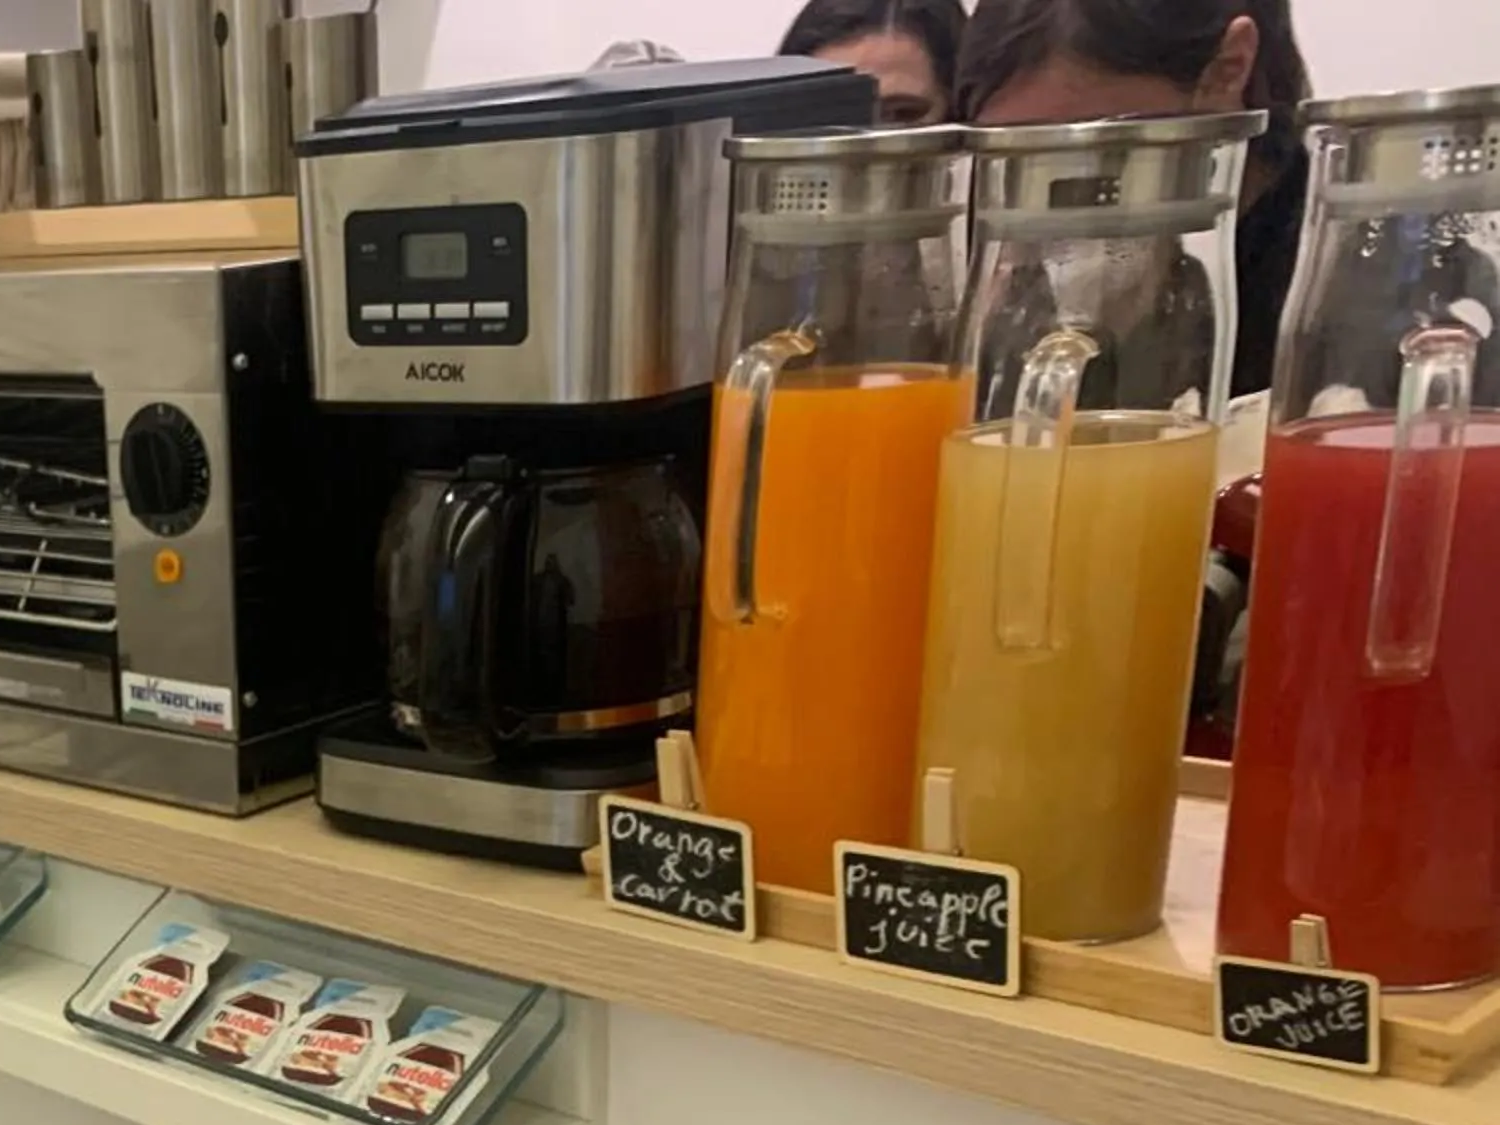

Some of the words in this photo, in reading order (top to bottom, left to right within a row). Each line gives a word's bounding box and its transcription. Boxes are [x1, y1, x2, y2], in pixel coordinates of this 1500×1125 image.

[404, 362, 465, 383] AICOK
[611, 811, 736, 878] Orange
[657, 852, 687, 883] &
[846, 863, 1009, 938] Pineapple
[128, 972, 184, 999] nutella
[1228, 979, 1366, 1037] ORANGE
[214, 1010, 274, 1037] nutella
[1276, 1001, 1365, 1049] JUICE
[297, 1033, 365, 1056] nutella
[386, 1063, 454, 1092] nutella
